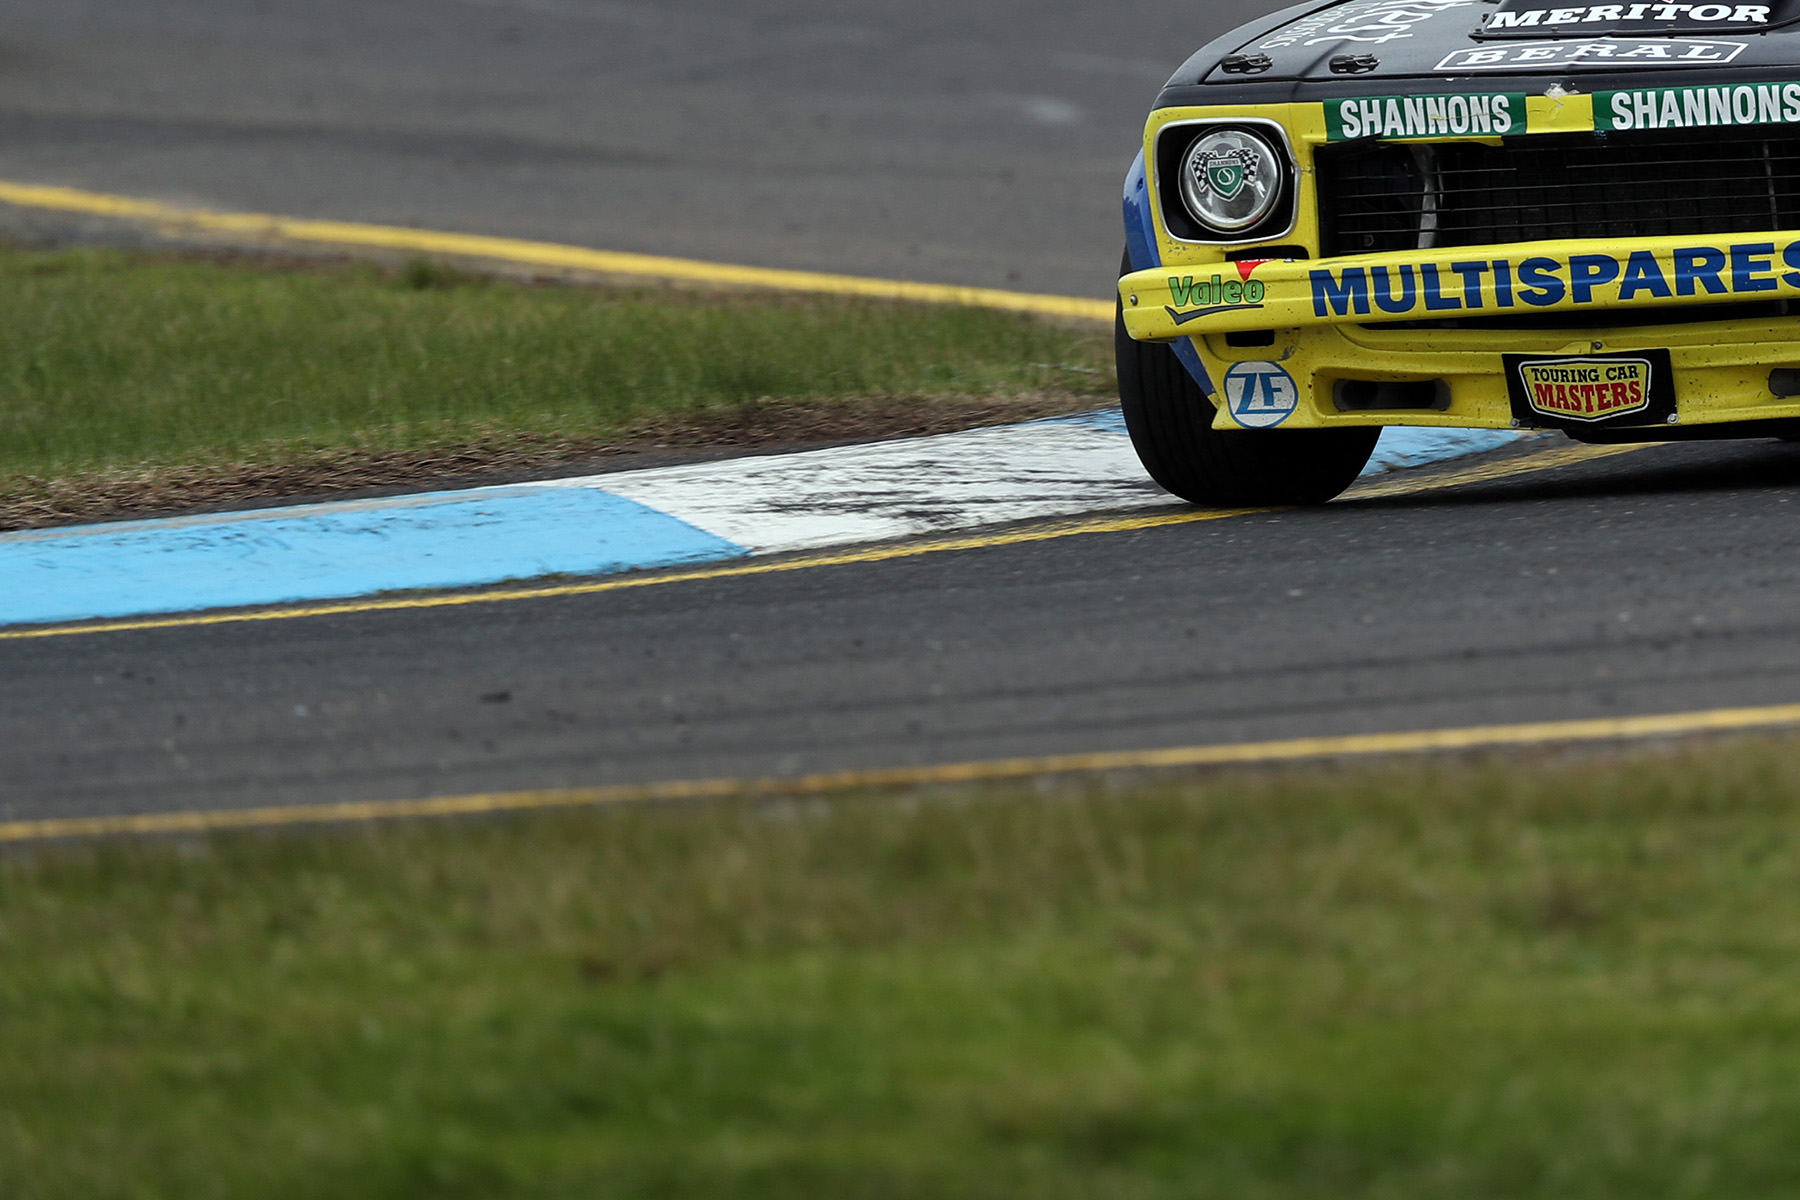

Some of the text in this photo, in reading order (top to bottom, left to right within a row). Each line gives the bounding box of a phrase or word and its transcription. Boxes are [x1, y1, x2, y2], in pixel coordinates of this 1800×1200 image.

[1487, 4, 1771, 29] MERITOR
[1456, 42, 1724, 66] BERAL
[1340, 94, 1512, 138] SHANNONS
[1167, 274, 1266, 307] Valeo
[1531, 365, 1639, 383] TOURING CAR
[1225, 369, 1298, 417] ZF
[1534, 380, 1642, 413] MASTERS
